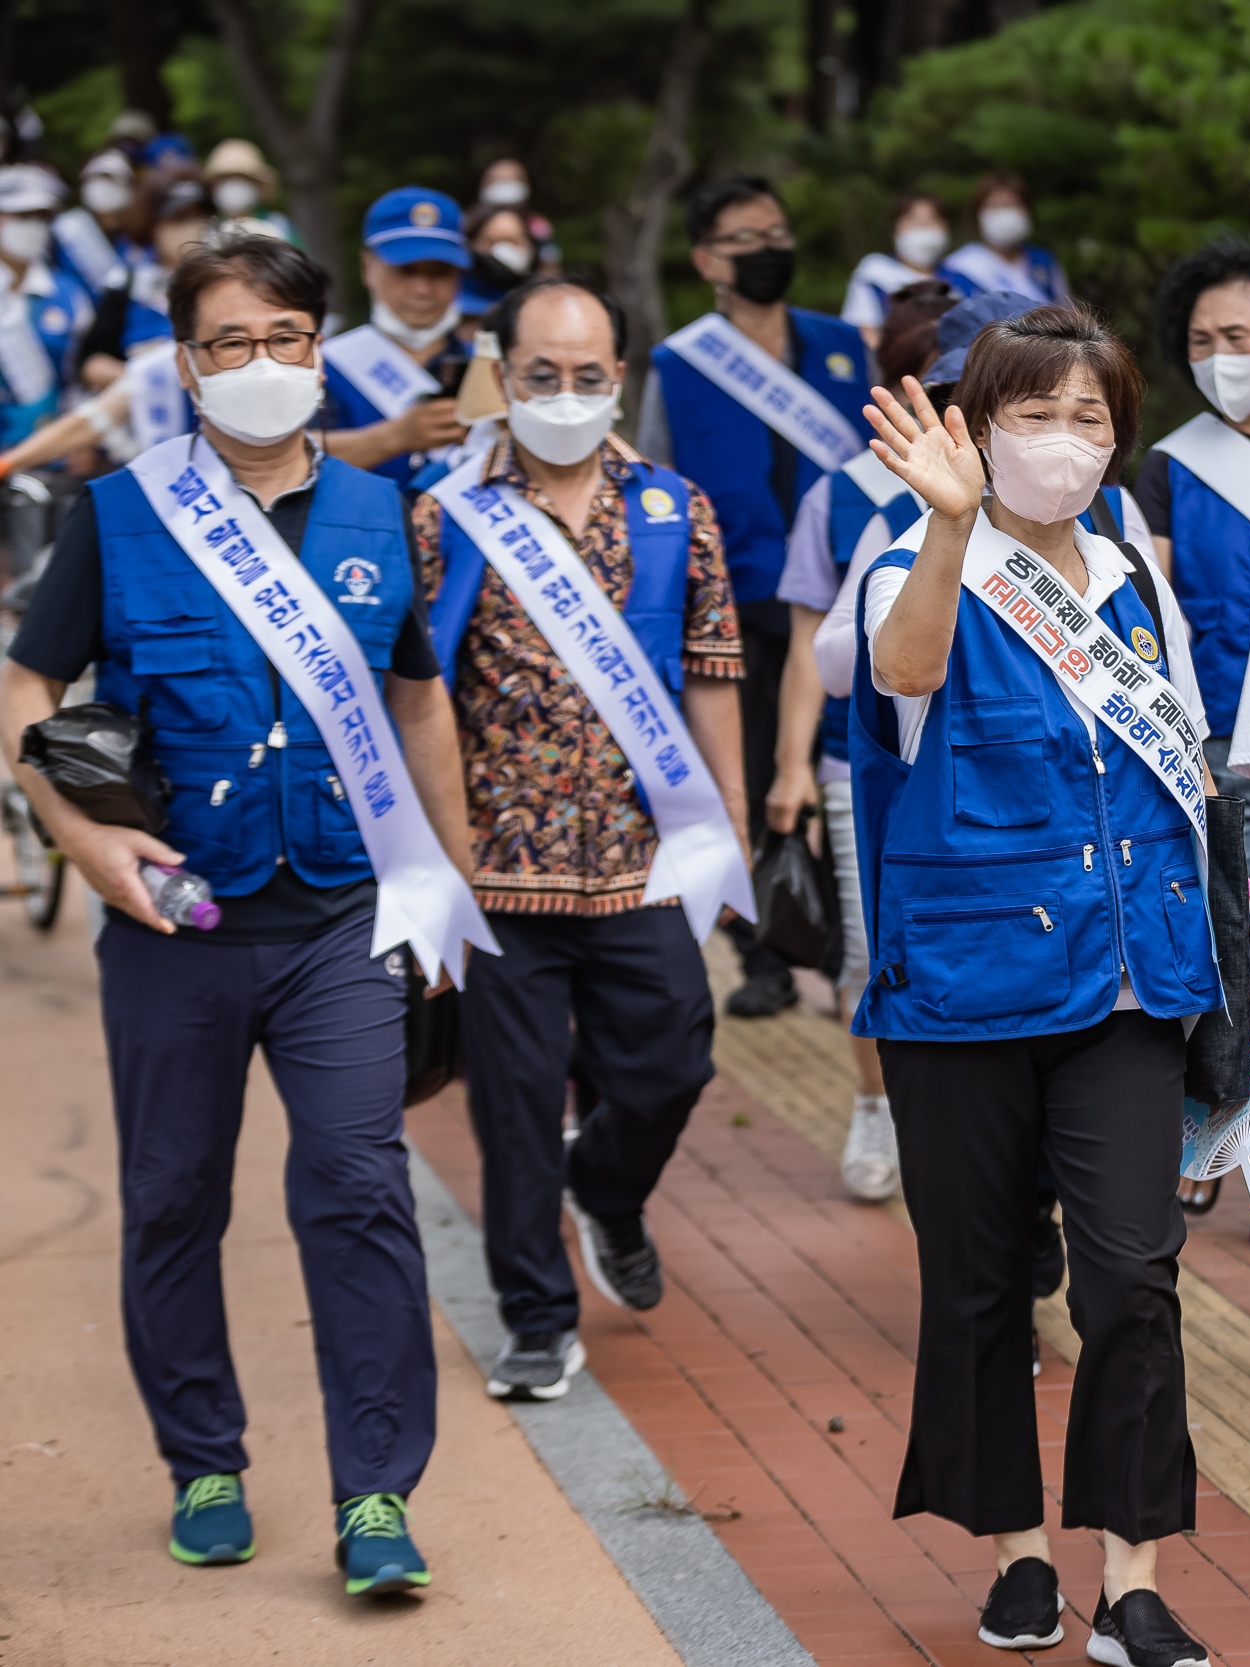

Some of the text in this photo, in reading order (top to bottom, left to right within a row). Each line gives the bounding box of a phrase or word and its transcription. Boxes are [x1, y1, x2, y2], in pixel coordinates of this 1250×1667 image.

[168, 466, 396, 819] 법질서 확립을 위한 기초질서 지키기 운동
[499, 523, 556, 581] 확립을
[541, 575, 585, 619] 위한
[568, 613, 636, 690] 기초질서
[620, 685, 669, 748] 지키기
[655, 743, 691, 788] 운동
[981, 573, 1090, 681] 코로나19
[1004, 551, 1088, 634] 여름철
[1088, 635, 1149, 690] 행락
